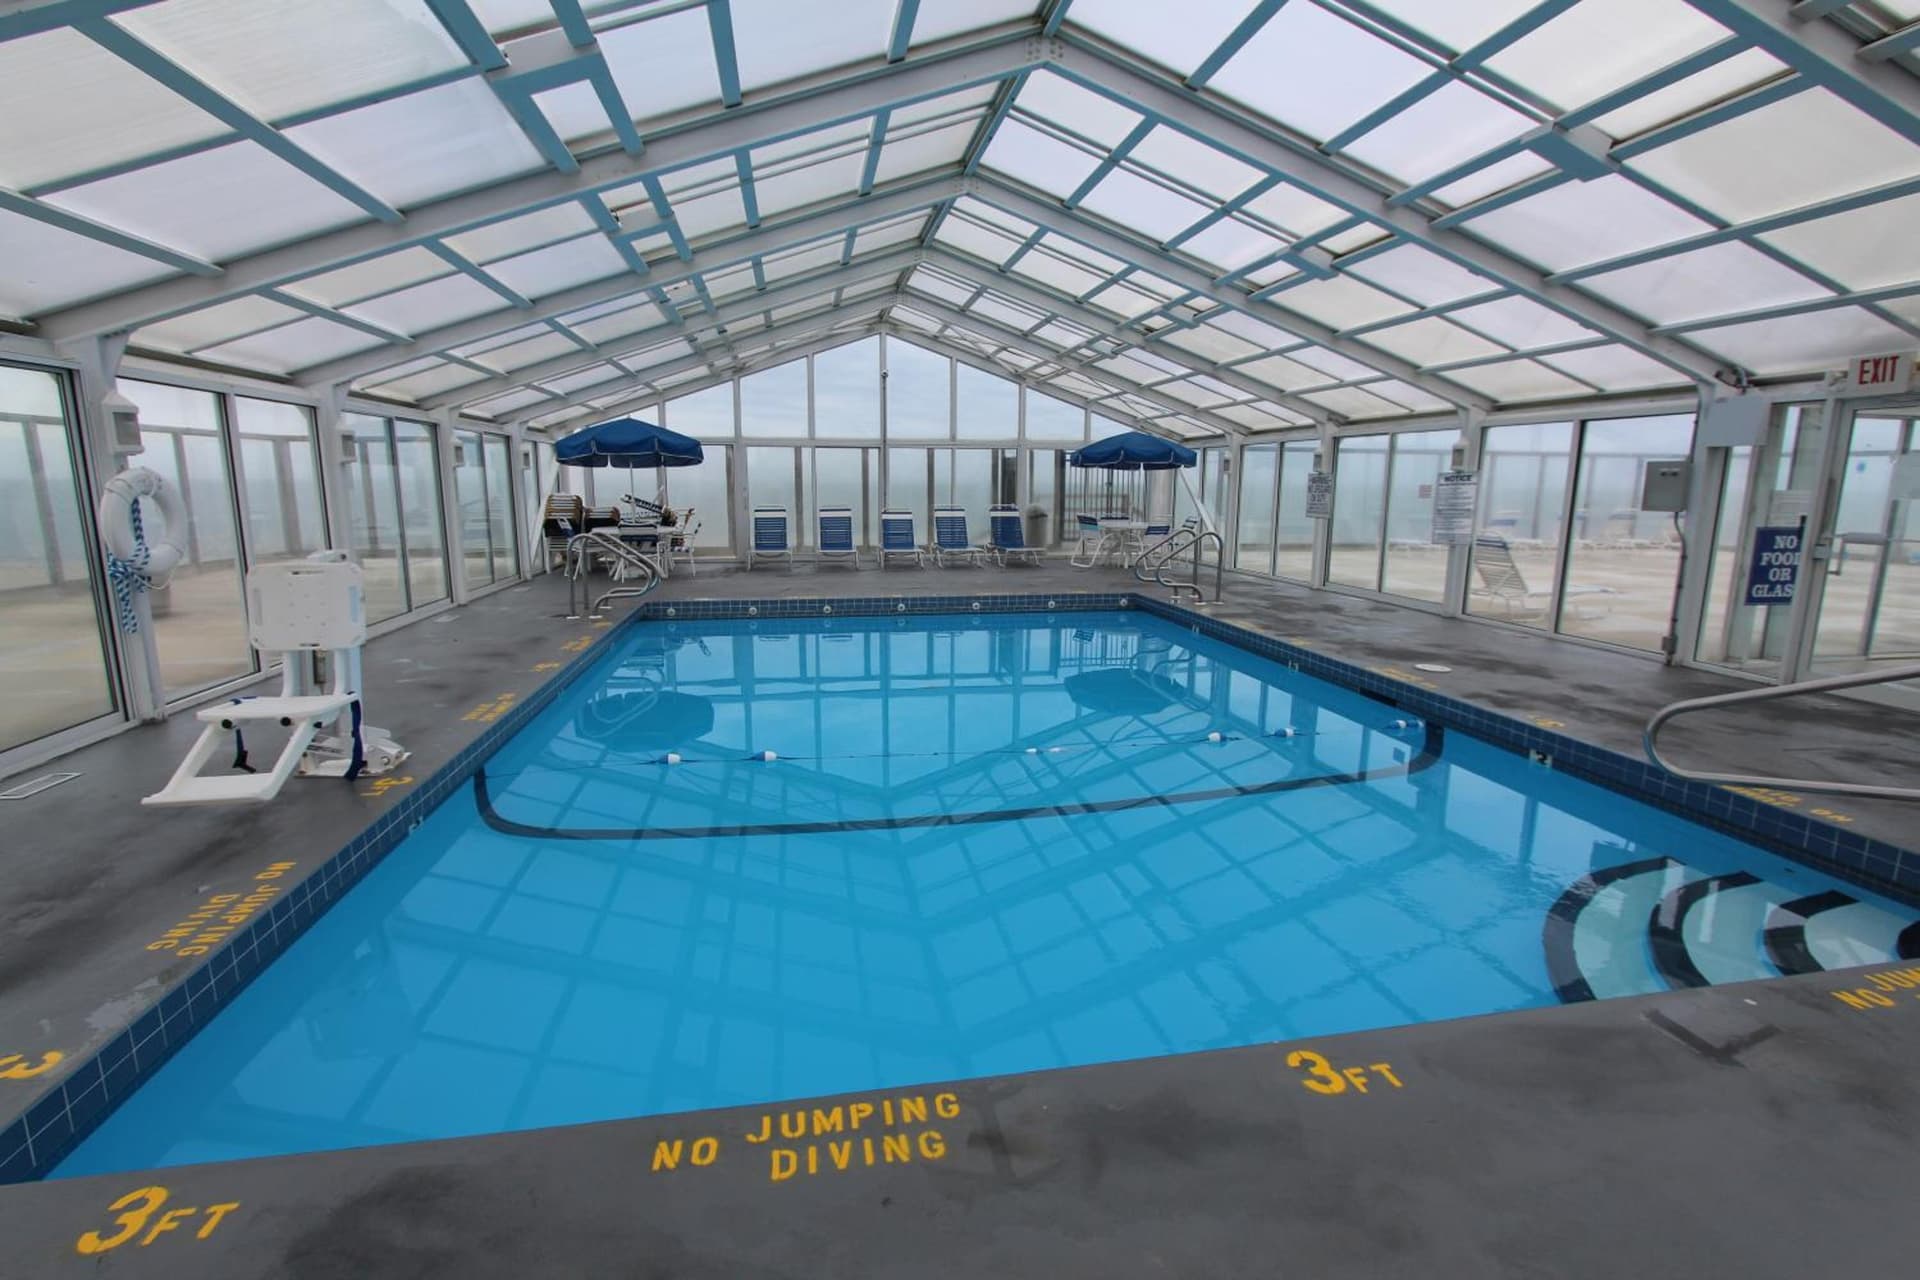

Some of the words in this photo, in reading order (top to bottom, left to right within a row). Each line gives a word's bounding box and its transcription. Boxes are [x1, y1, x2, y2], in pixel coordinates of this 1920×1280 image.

[1858, 355, 1900, 385] EXIT
[1444, 474, 1473, 483] NOTICE
[1774, 535, 1797, 549] NO
[1769, 568, 1792, 581] OR
[1752, 584, 1793, 597] GLAS
[253, 861, 297, 880] NO
[145, 893, 242, 950] DIVING
[176, 884, 281, 957] JUMPING
[1829, 988, 1895, 1009] NO
[651, 1136, 719, 1171] NO
[745, 1092, 961, 1144] JUMPING
[770, 1130, 947, 1181] DIVING
